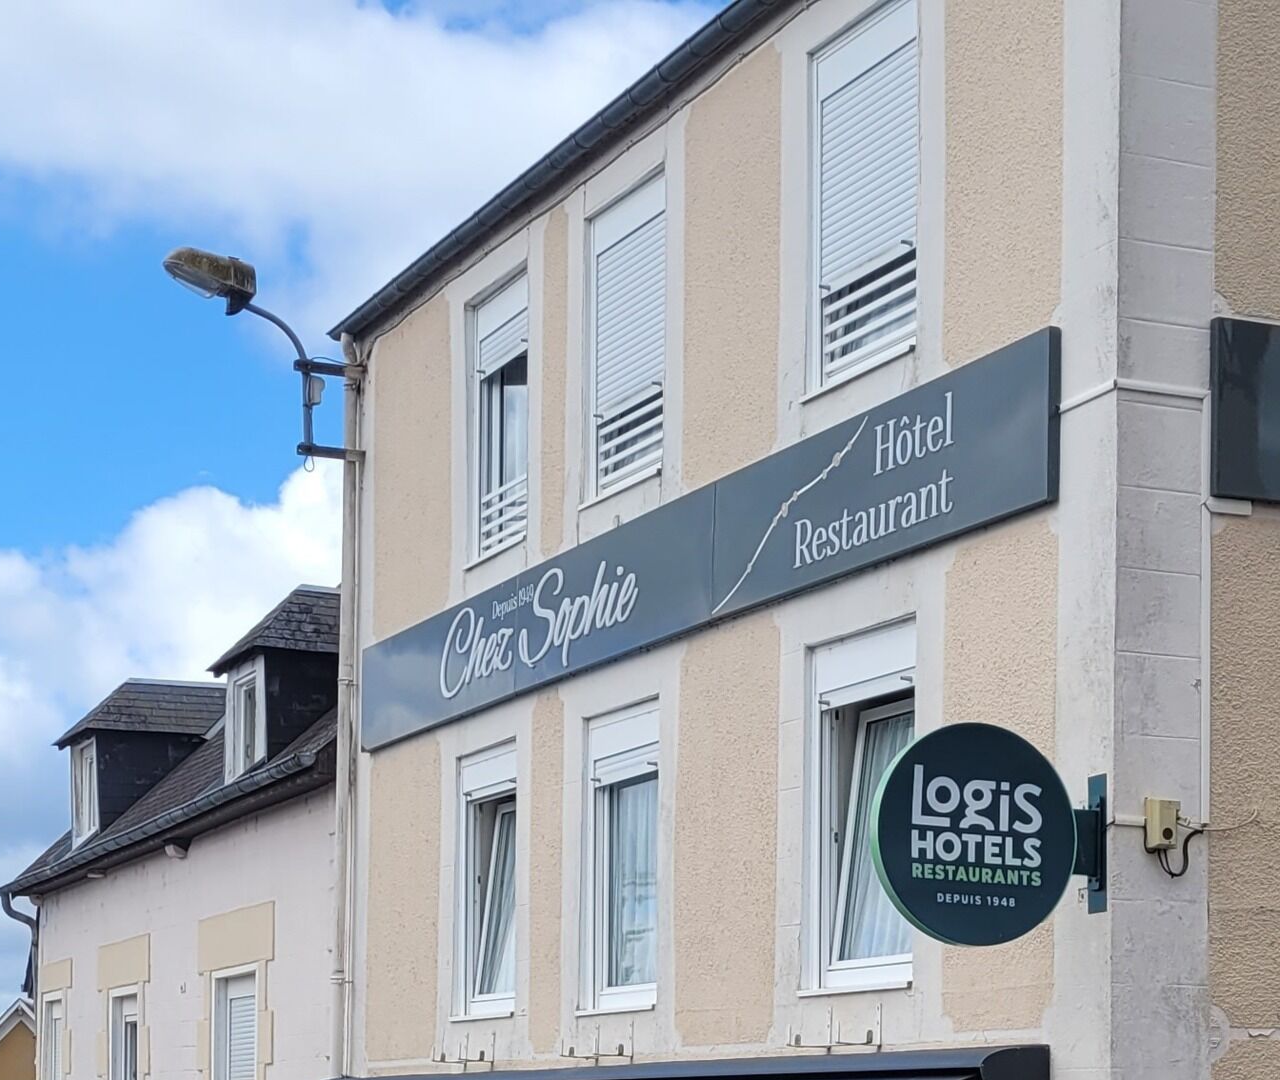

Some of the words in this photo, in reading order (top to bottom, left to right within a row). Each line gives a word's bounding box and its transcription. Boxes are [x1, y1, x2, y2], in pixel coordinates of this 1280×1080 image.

[873, 392, 954, 476] Hôtel
[793, 469, 953, 568] Restaurant
[492, 593, 517, 620] Depuis
[518, 584, 534, 607] 1949
[440, 608, 513, 698] Chez
[519, 561, 639, 668] Sophie
[910, 829, 1042, 868] HOTELS
[911, 862, 1042, 887] RESTAURANTS
[936, 892, 982, 905] DEPUIS
[986, 895, 1016, 908] 1948
